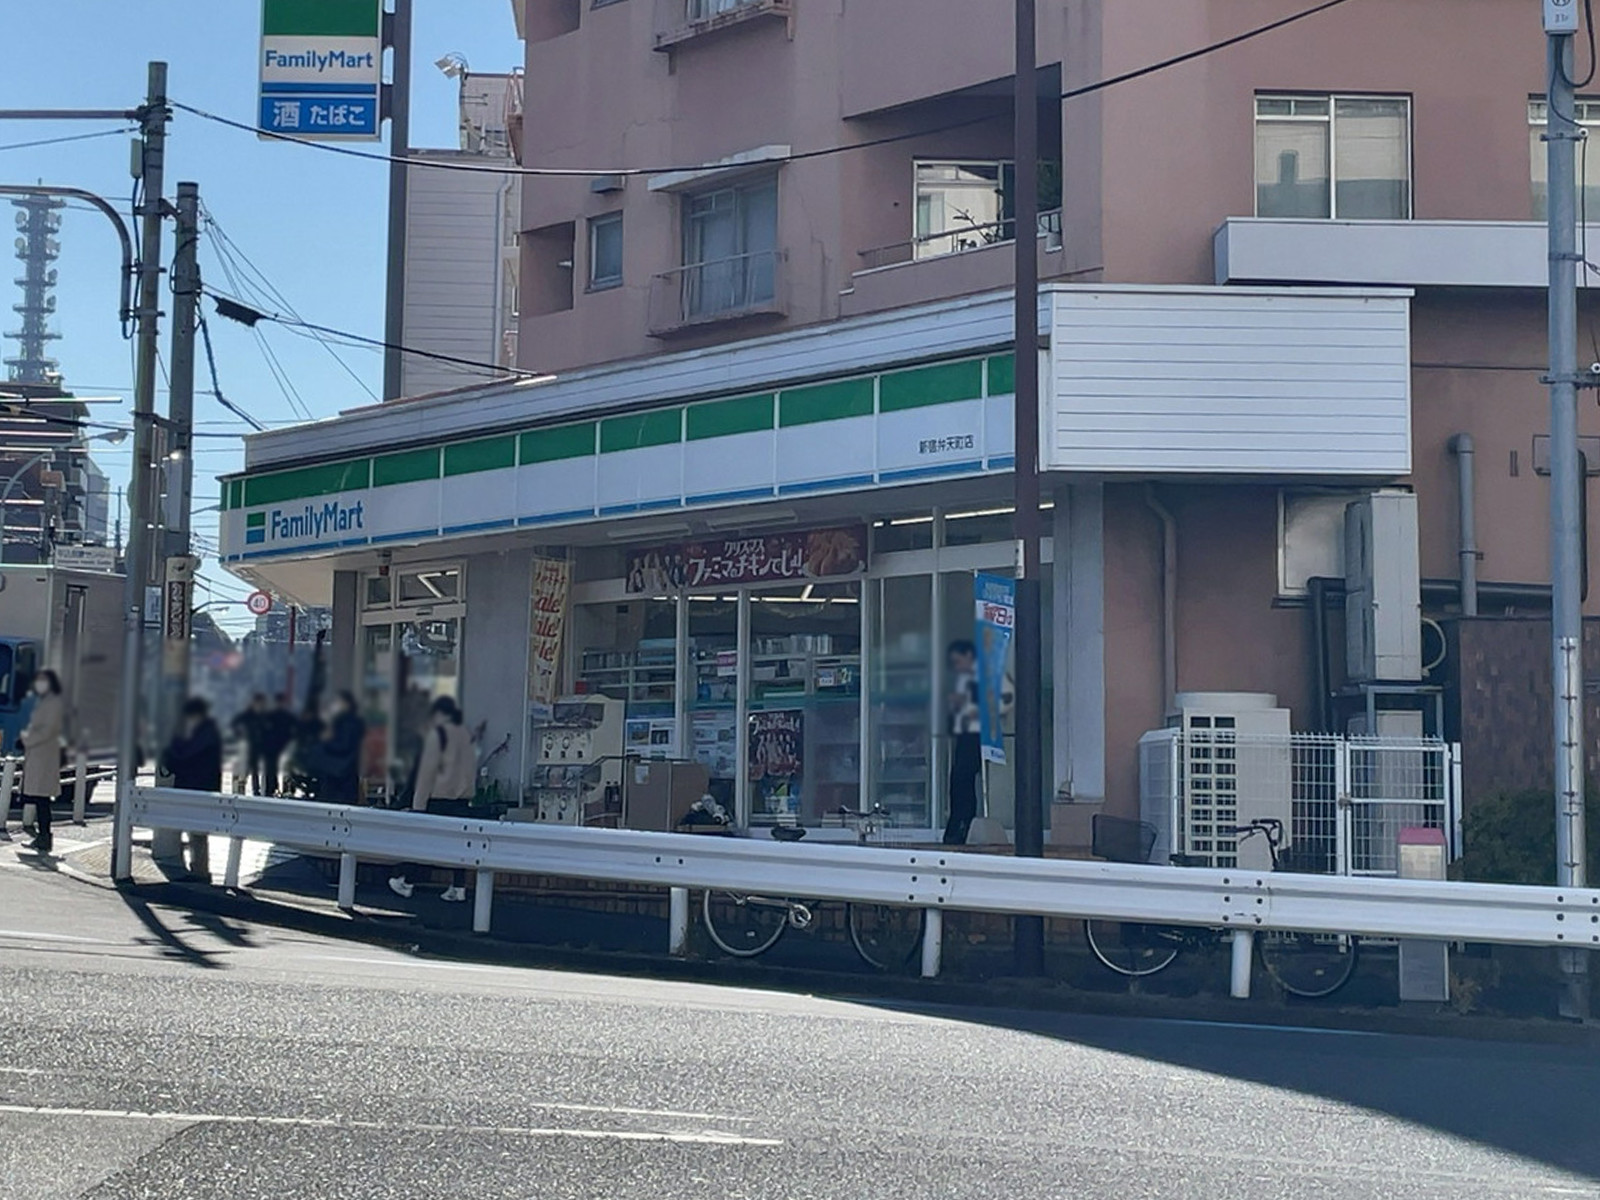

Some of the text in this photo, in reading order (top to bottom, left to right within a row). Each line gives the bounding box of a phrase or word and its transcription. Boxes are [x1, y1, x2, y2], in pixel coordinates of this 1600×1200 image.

[265, 50, 374, 73] FamilyMart
[273, 101, 366, 128] 酒 たばこ
[271, 500, 363, 540] FamilyMart
[724, 538, 765, 558] クリスマス
[253, 597, 266, 609] 40
